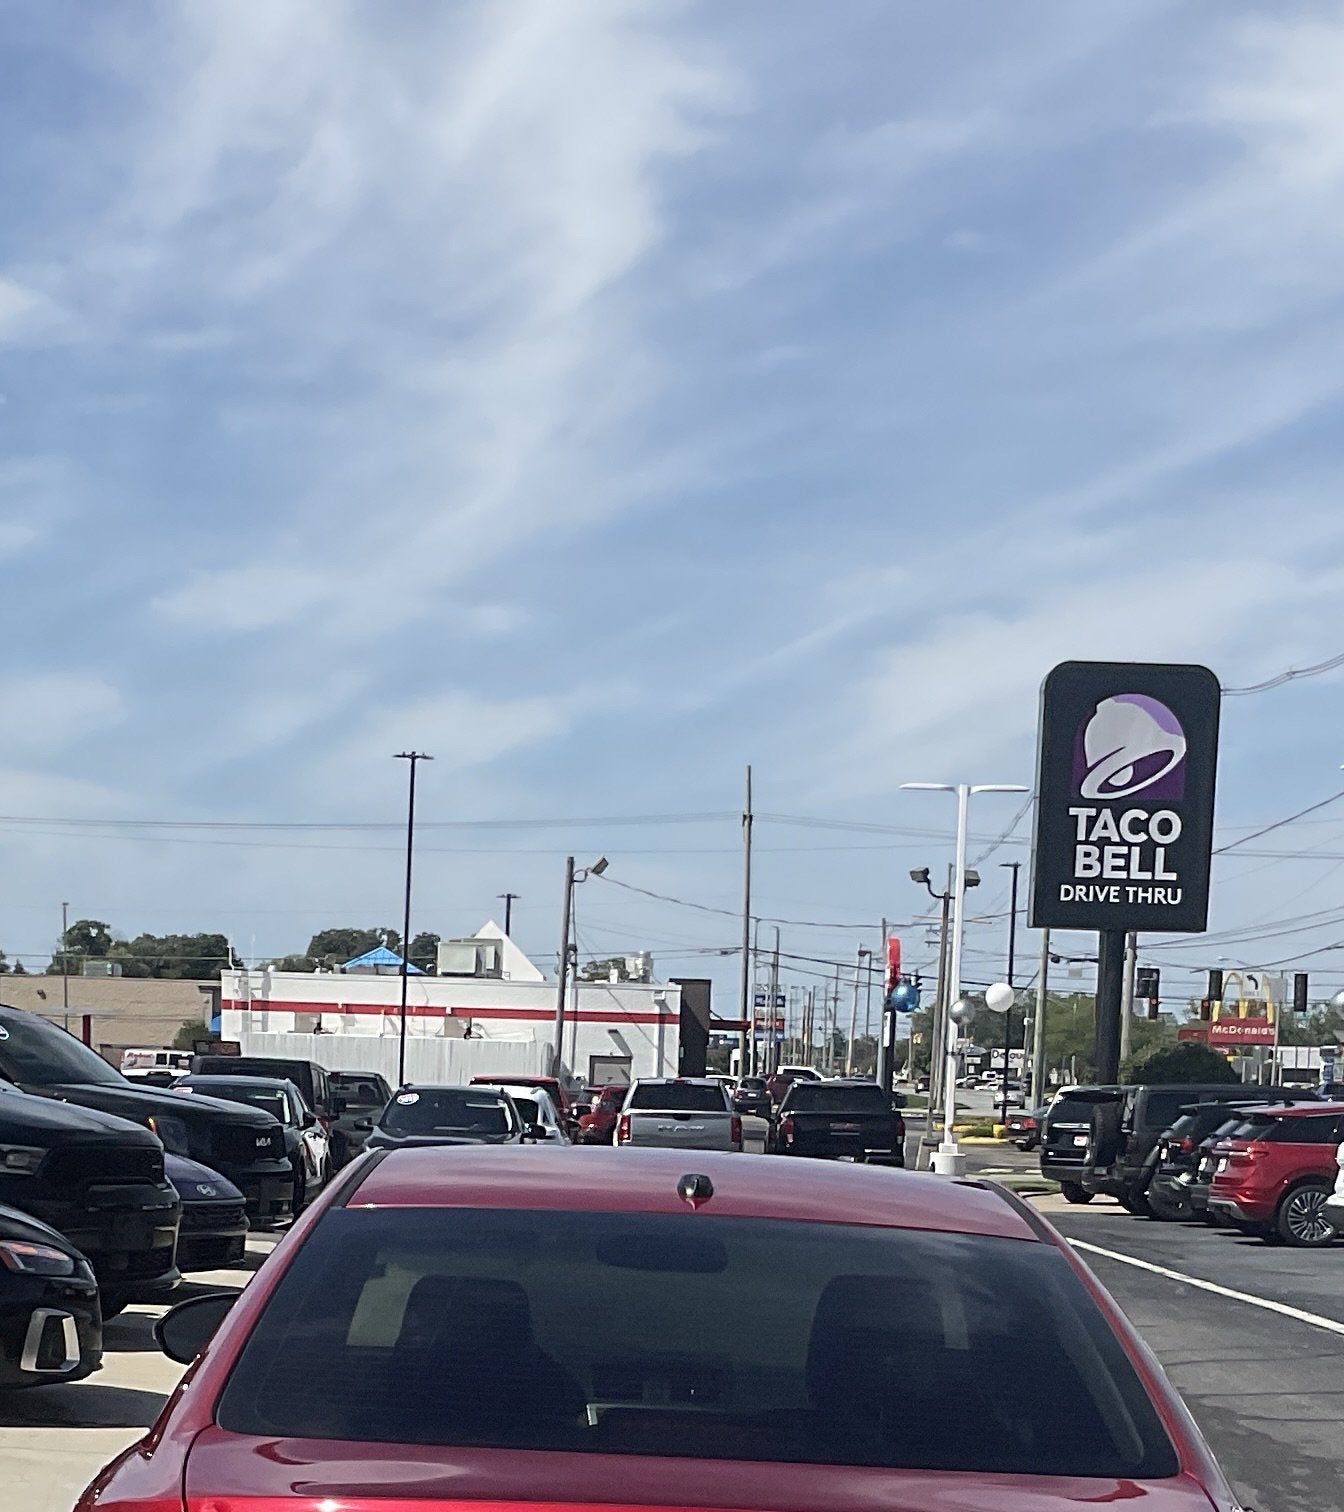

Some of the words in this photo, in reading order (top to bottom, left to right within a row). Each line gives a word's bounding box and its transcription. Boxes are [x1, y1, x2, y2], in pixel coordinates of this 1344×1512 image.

[1068, 807, 1182, 844] TACO
[1074, 844, 1177, 881] BELL
[1059, 884, 1120, 903] DRIVE
[1125, 886, 1182, 905] THRU
